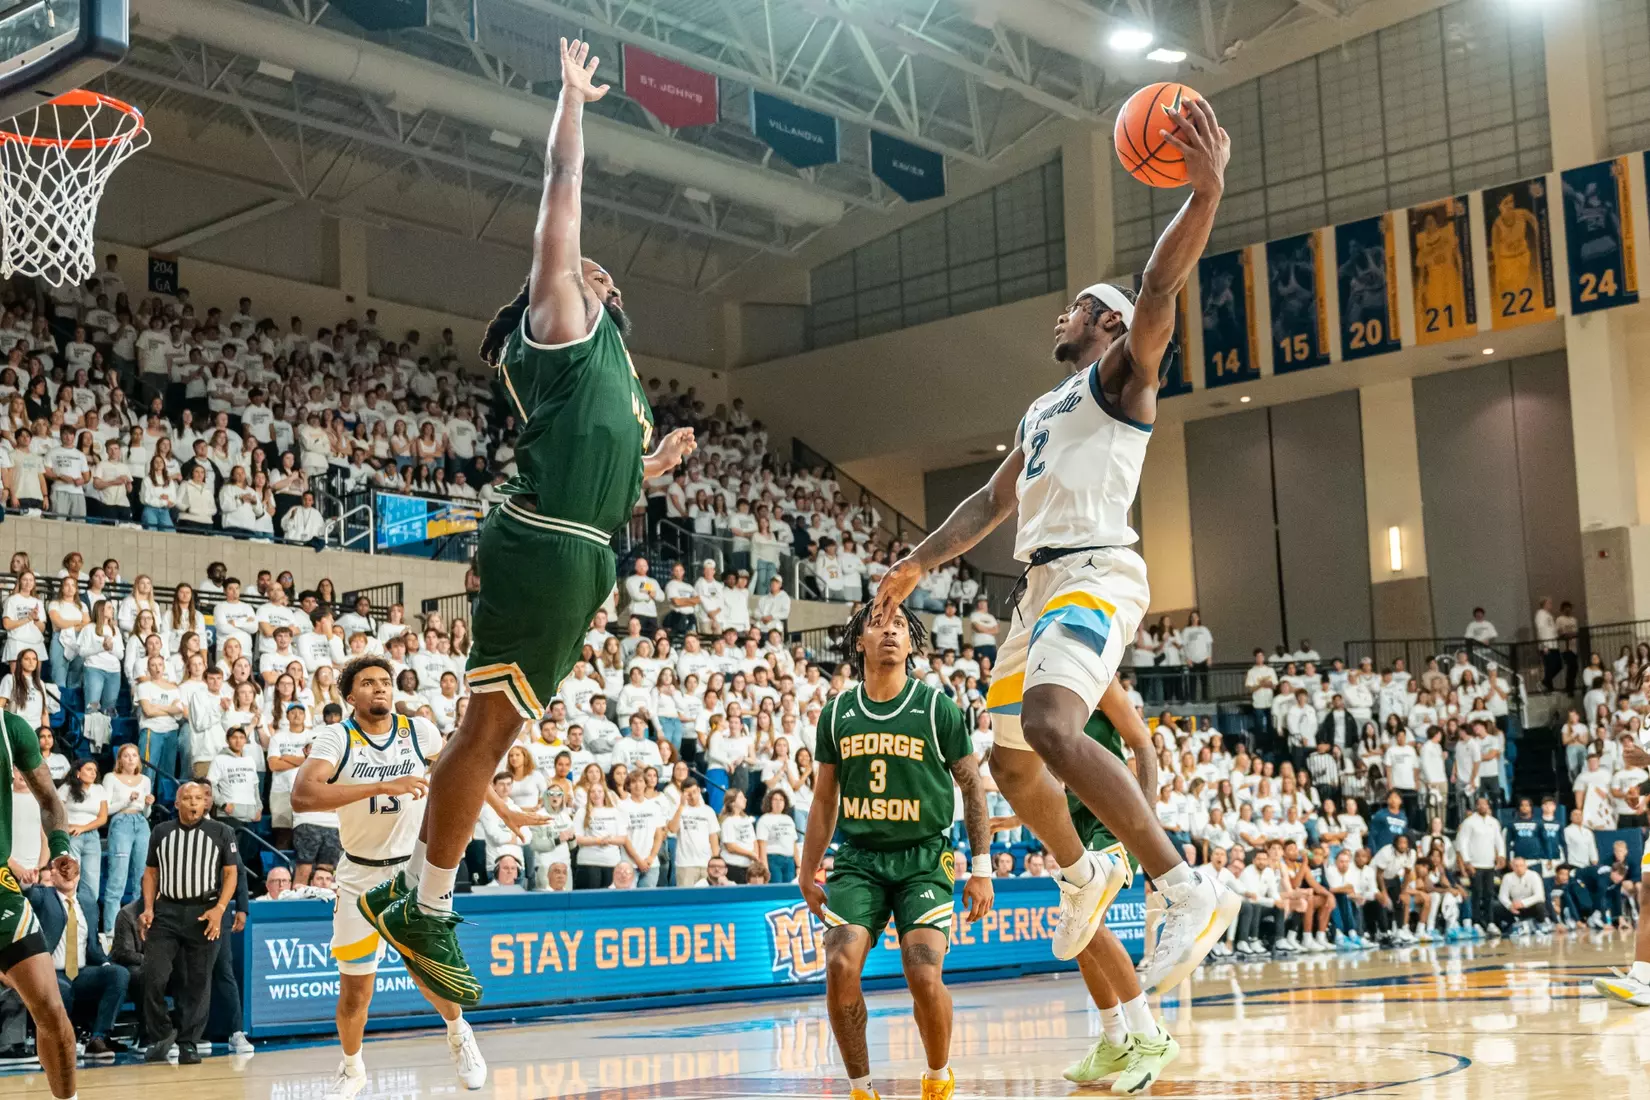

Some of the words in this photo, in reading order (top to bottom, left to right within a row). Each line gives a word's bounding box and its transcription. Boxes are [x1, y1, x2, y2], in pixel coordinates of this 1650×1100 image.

[640, 75, 657, 88] ST.
[660, 84, 703, 104] JOHN'S
[769, 119, 825, 144] VILLANOVA
[153, 260, 174, 276] 204
[155, 277, 172, 292] GA
[1579, 268, 1618, 303] 24
[1425, 303, 1454, 333] 21
[1502, 288, 1535, 318] 22
[1279, 333, 1309, 363] 15
[1350, 318, 1383, 350] 20
[1211, 348, 1241, 377] 14
[1026, 429, 1051, 481] 2
[840, 732, 925, 762] GEORGE
[351, 759, 416, 782] Marquette
[869, 759, 888, 794] 3
[843, 796, 920, 822] MASON
[983, 906, 1062, 944] PERKS
[490, 930, 584, 976] STAY
[595, 923, 736, 970] GOLDEN
